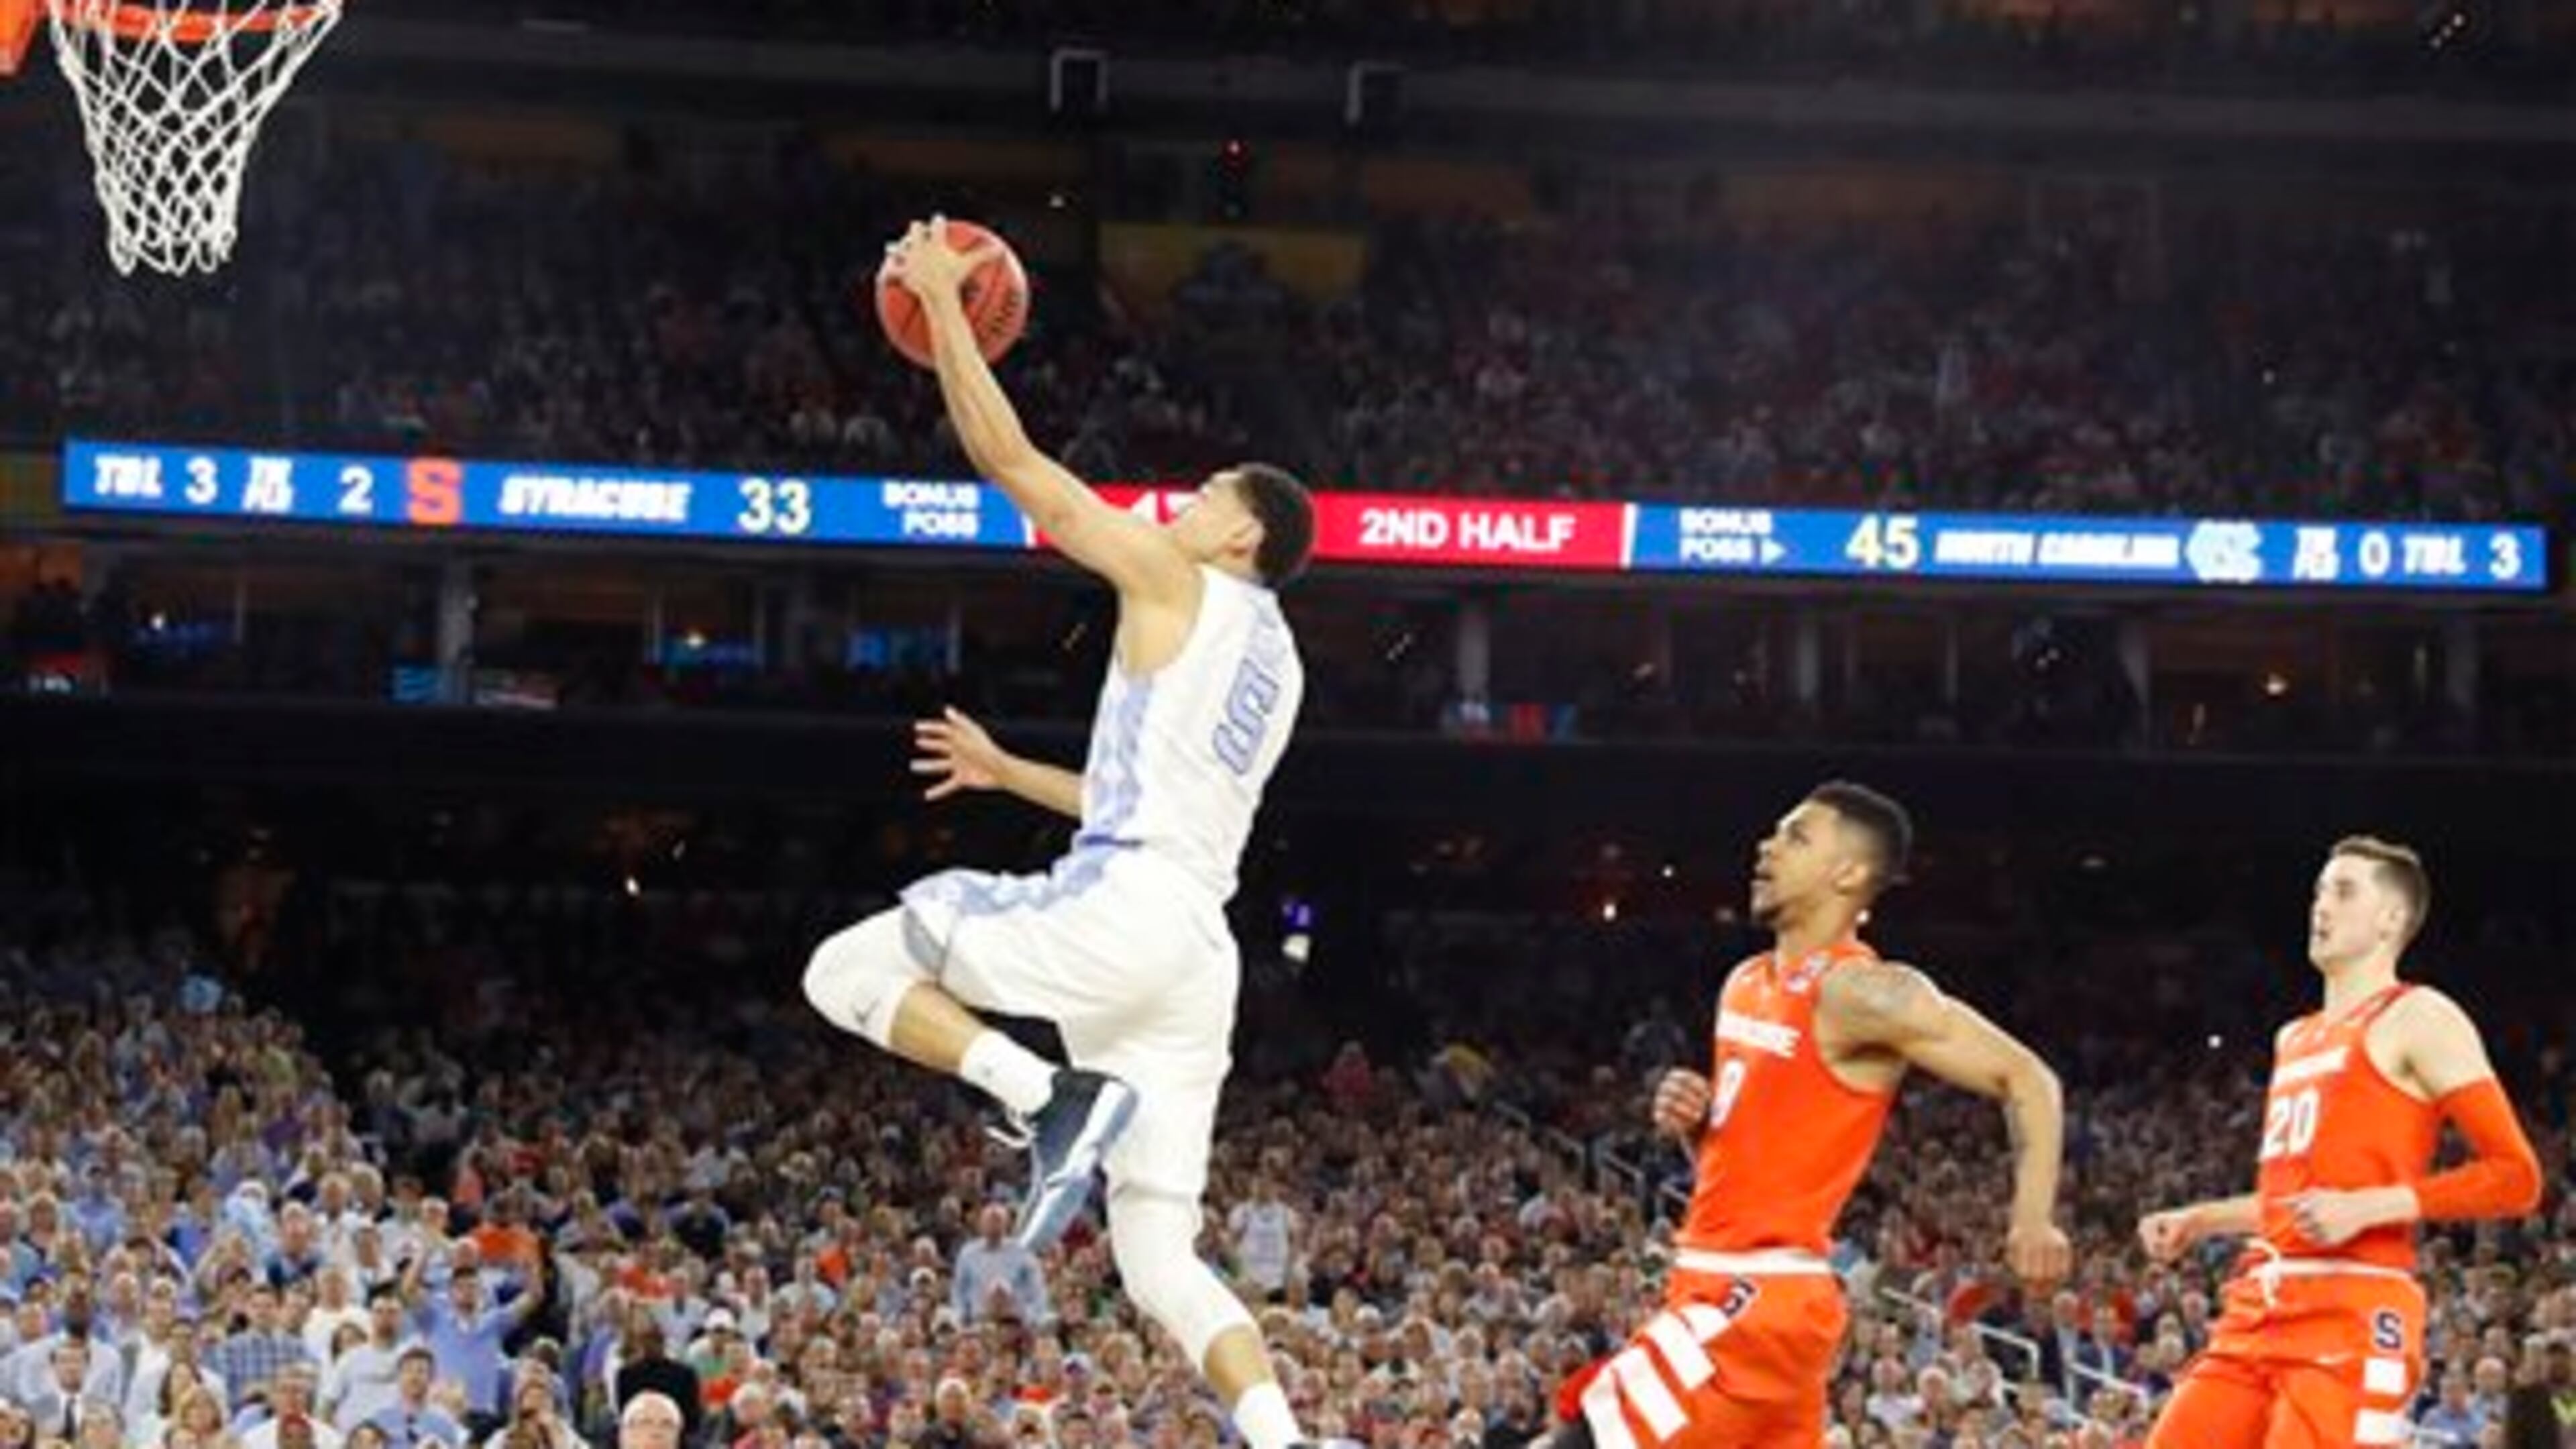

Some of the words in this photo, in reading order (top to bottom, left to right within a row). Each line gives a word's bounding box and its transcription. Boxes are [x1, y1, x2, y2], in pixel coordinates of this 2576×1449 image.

[185, 455, 219, 505] 3
[339, 465, 374, 515] 2
[405, 456, 464, 527] S
[498, 474, 692, 523] SYRACUSE
[738, 477, 812, 536] 33
[882, 481, 979, 509] BONUS
[1359, 507, 1449, 549] 2ND
[1458, 511, 1577, 553] HALF
[1678, 507, 1774, 537] BONUS
[1845, 513, 1921, 571] 45
[2359, 531, 2392, 578] 0
[2489, 532, 2522, 581] 3
[1212, 656, 1280, 776] 5
[2258, 1085, 2322, 1161] 20
[2374, 1310, 2403, 1350] S
